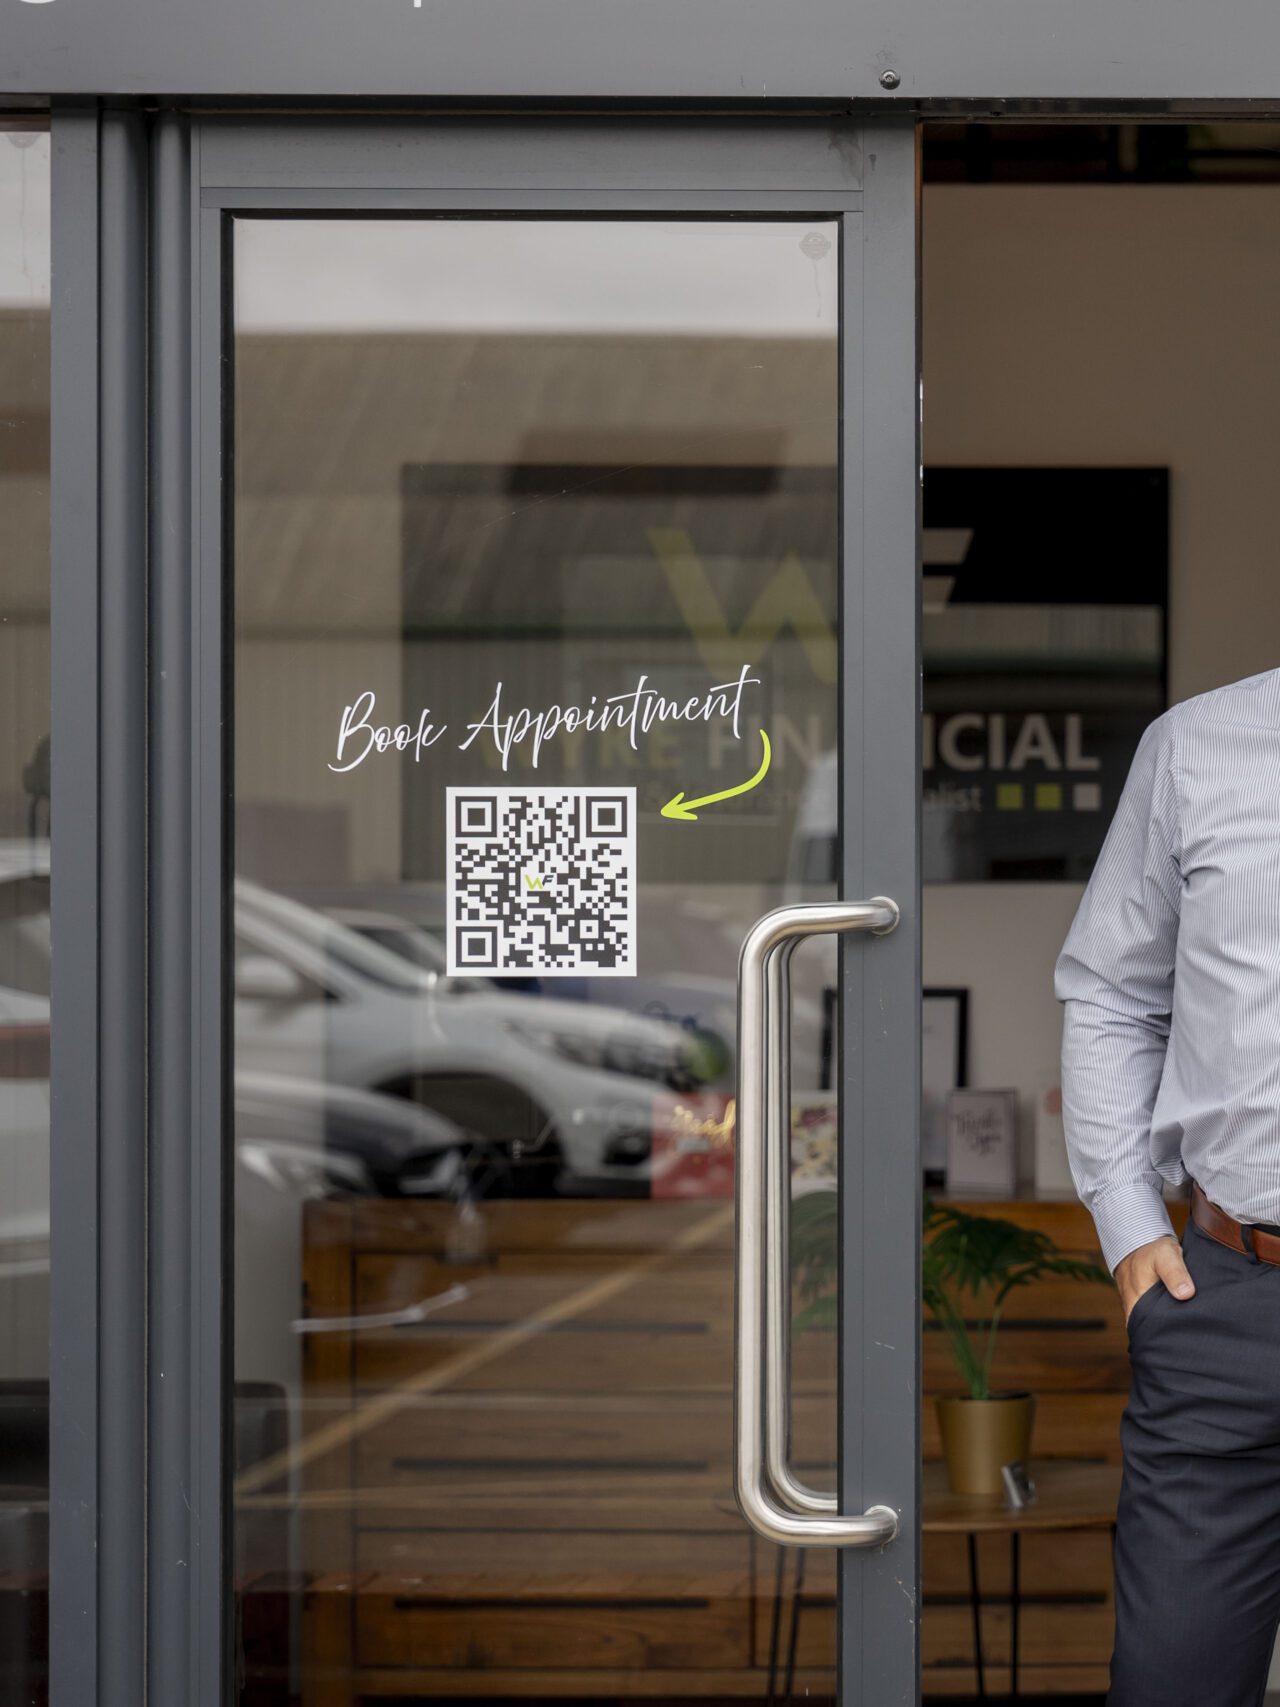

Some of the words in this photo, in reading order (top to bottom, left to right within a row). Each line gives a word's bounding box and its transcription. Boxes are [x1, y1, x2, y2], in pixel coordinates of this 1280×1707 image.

[327, 691, 448, 773] Book
[458, 664, 762, 772] Appointment
[708, 712, 1100, 771] FINCIAL
